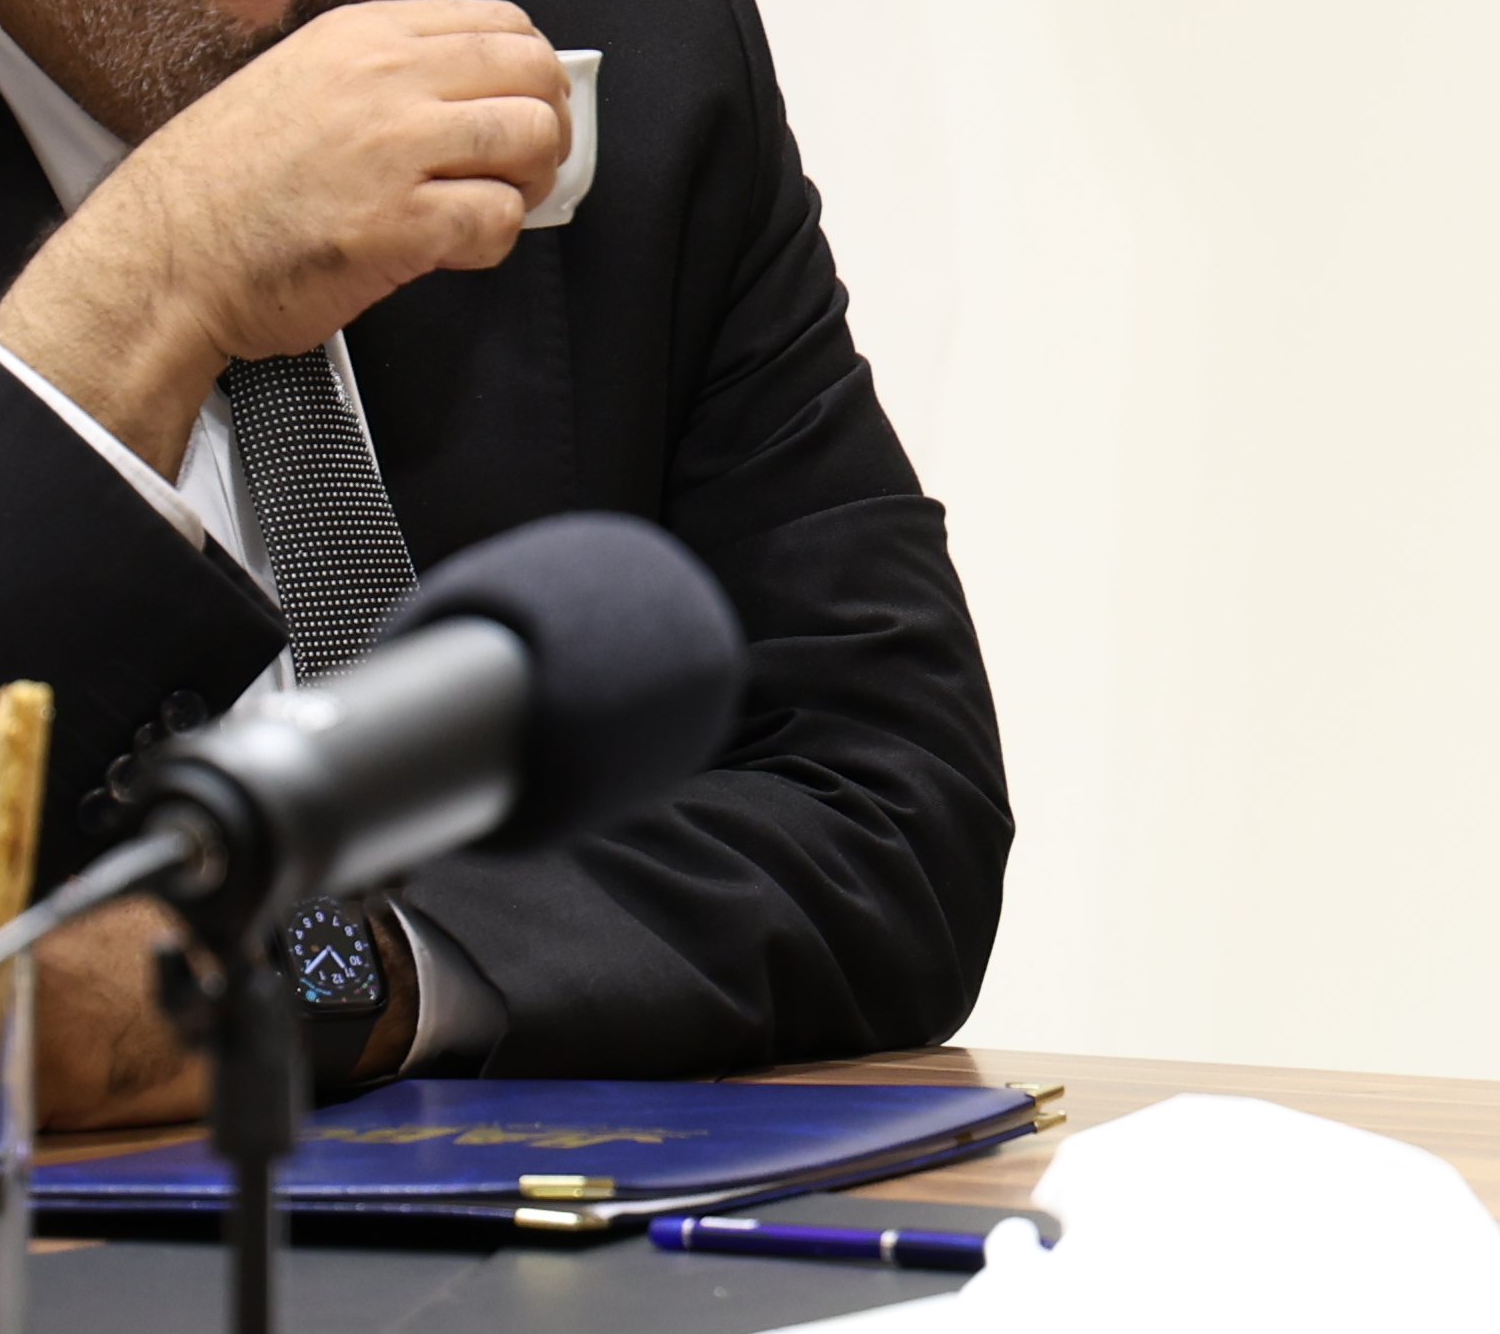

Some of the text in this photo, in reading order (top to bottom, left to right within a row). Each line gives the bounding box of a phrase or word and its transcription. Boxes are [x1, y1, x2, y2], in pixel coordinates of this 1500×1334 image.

[315, 911, 325, 922] 6
[332, 915, 340, 926] 7
[303, 917, 312, 928] 5
[295, 929, 304, 940] 4
[344, 926, 354, 937] 8
[294, 944, 304, 955] 3
[354, 940, 364, 951] 9
[349, 955, 362, 966] 10
[319, 970, 327, 981] 1
[331, 973, 345, 984] 12
[344, 968, 356, 978] 11
